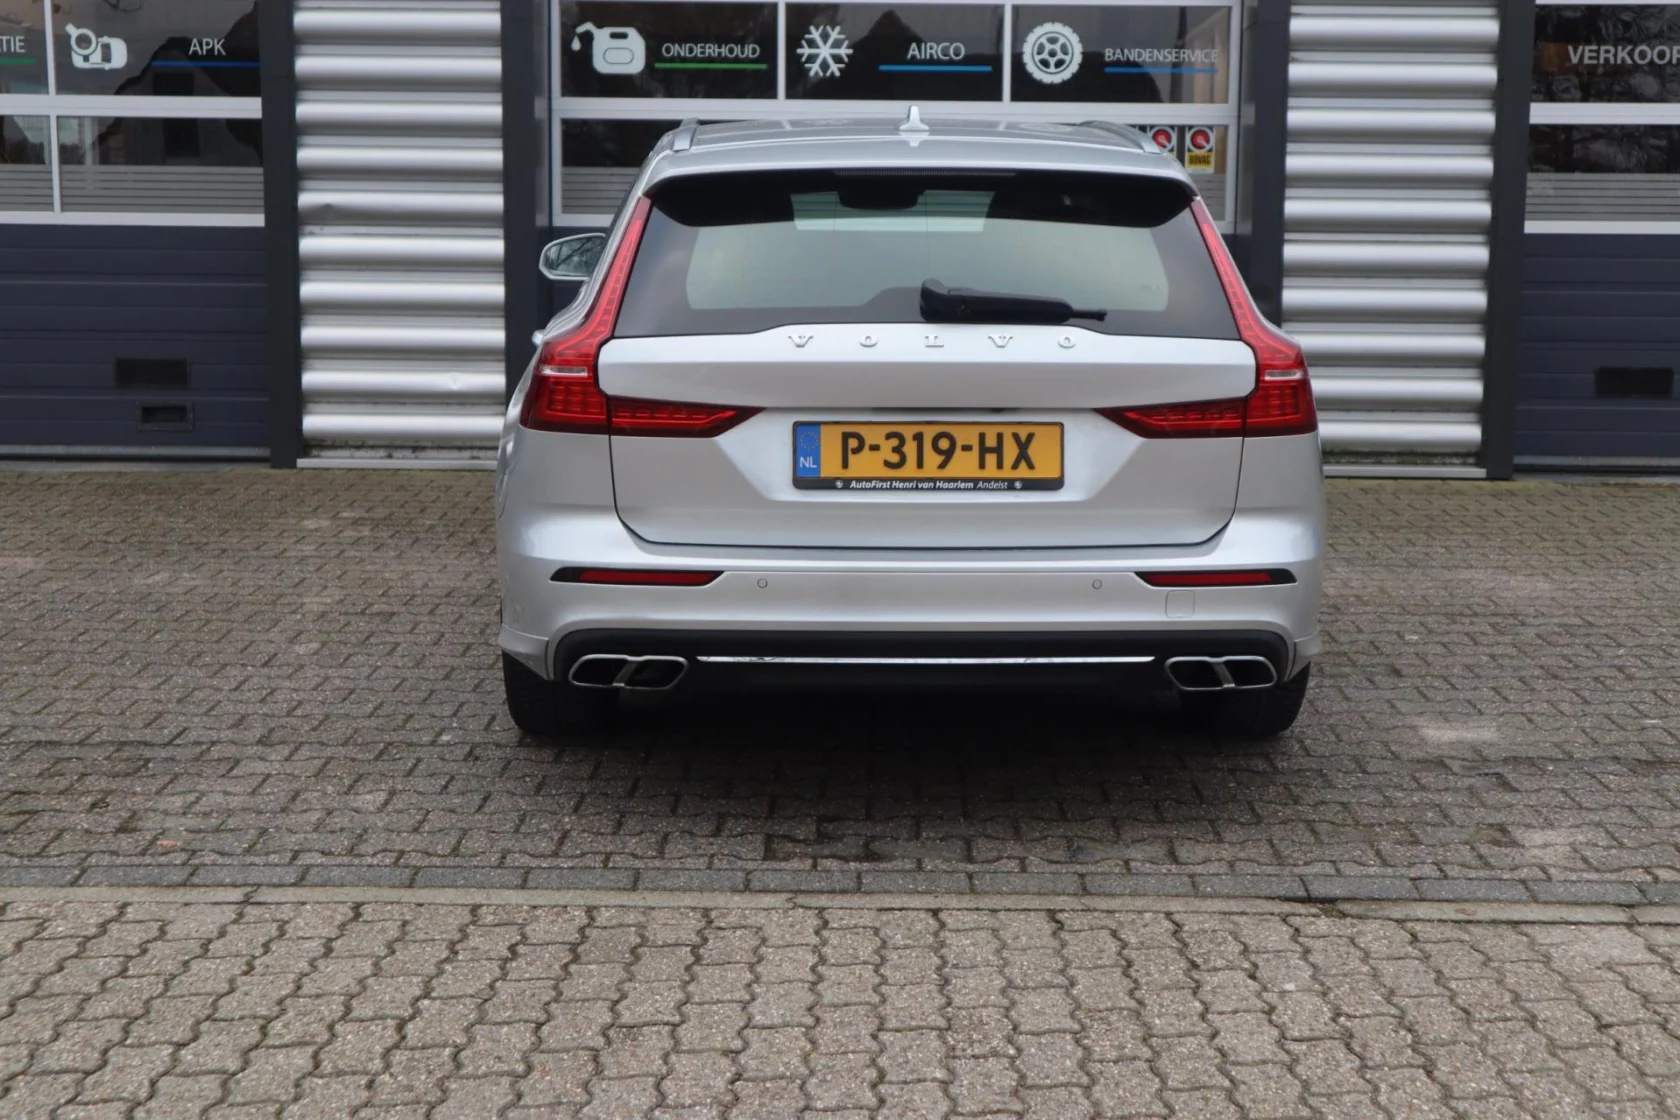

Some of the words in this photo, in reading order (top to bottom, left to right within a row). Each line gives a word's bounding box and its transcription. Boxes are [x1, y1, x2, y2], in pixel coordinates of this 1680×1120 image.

[0, 35, 26, 53] TIE
[188, 38, 226, 56] APK
[661, 43, 760, 58] ONDERHOUD
[907, 42, 966, 60] AIRCO
[1104, 48, 1220, 63] BANDENSERVICE
[788, 335, 1077, 349] VOLVO
[841, 431, 1036, 470] P-319-HX
[799, 456, 818, 469] NL
[850, 480, 891, 489] AutoFirst
[892, 480, 917, 489] Henri
[936, 480, 974, 489] Haarlem
